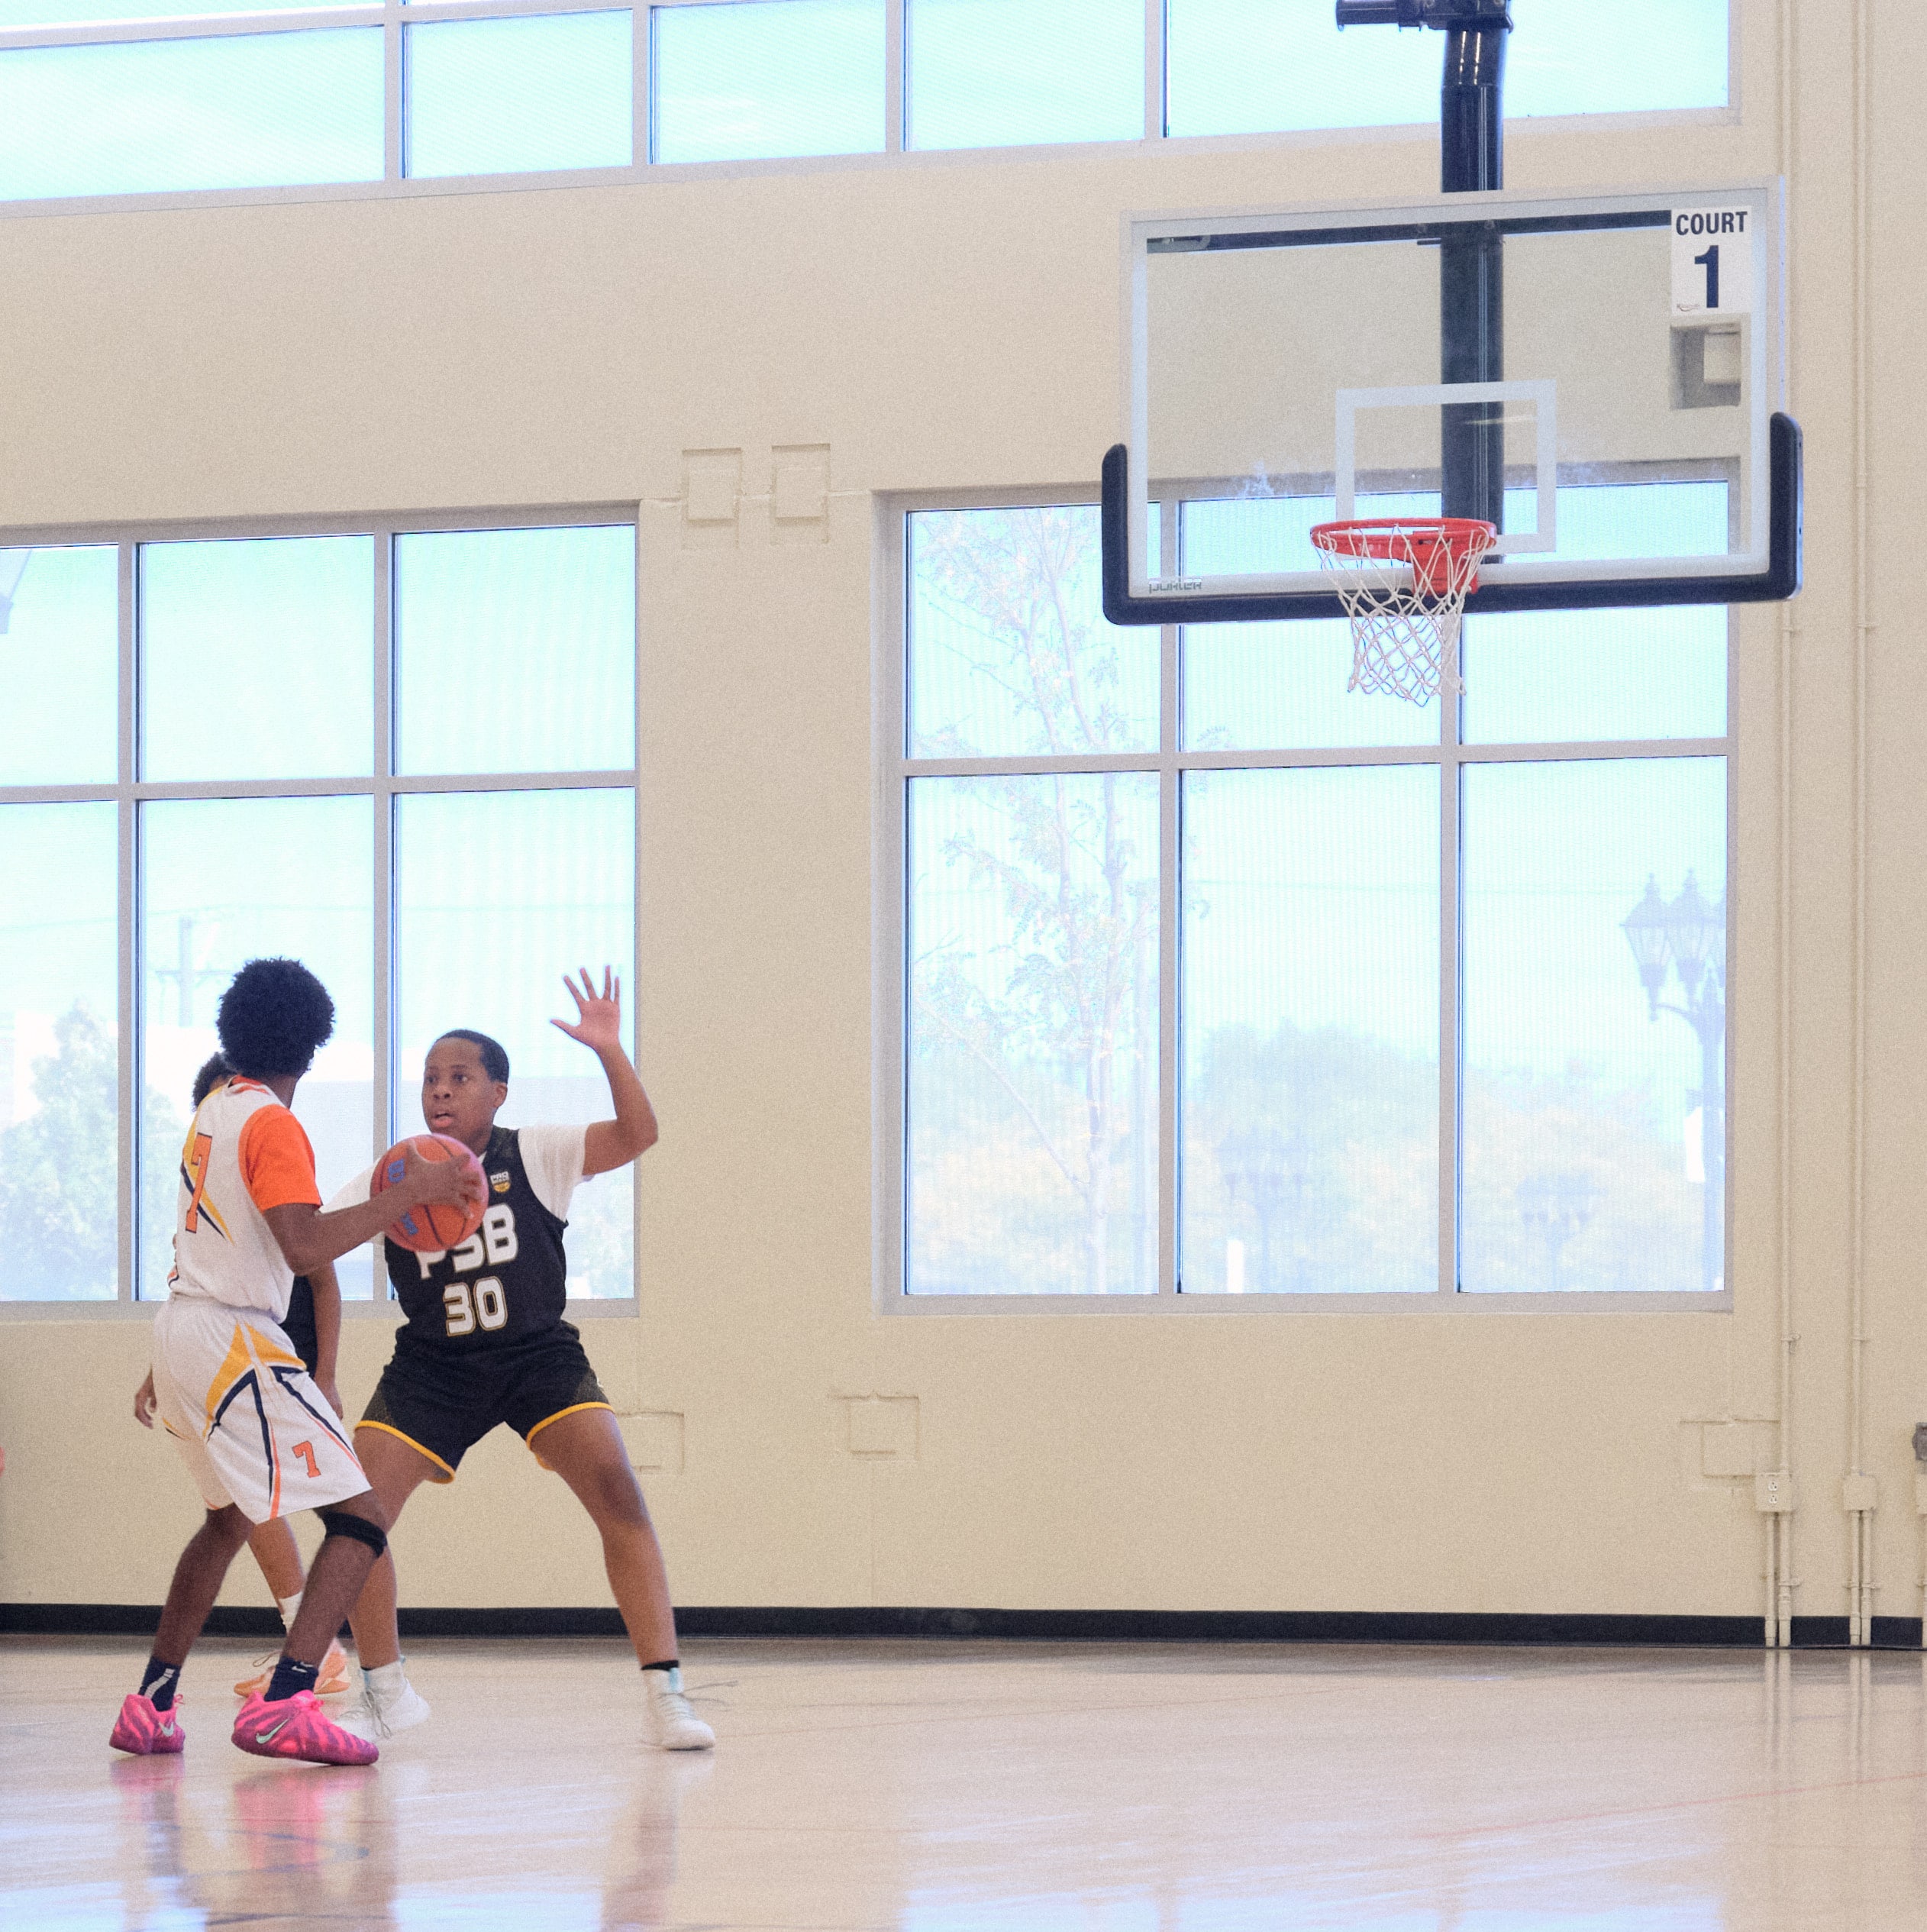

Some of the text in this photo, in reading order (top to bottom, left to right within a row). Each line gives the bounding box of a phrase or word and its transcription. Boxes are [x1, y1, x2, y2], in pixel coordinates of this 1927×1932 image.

[1676, 211, 1748, 236] COURT
[1694, 244, 1719, 309] 1
[185, 1131, 213, 1234] 7
[442, 1275, 508, 1337] 30
[292, 1439, 321, 1478] 7
